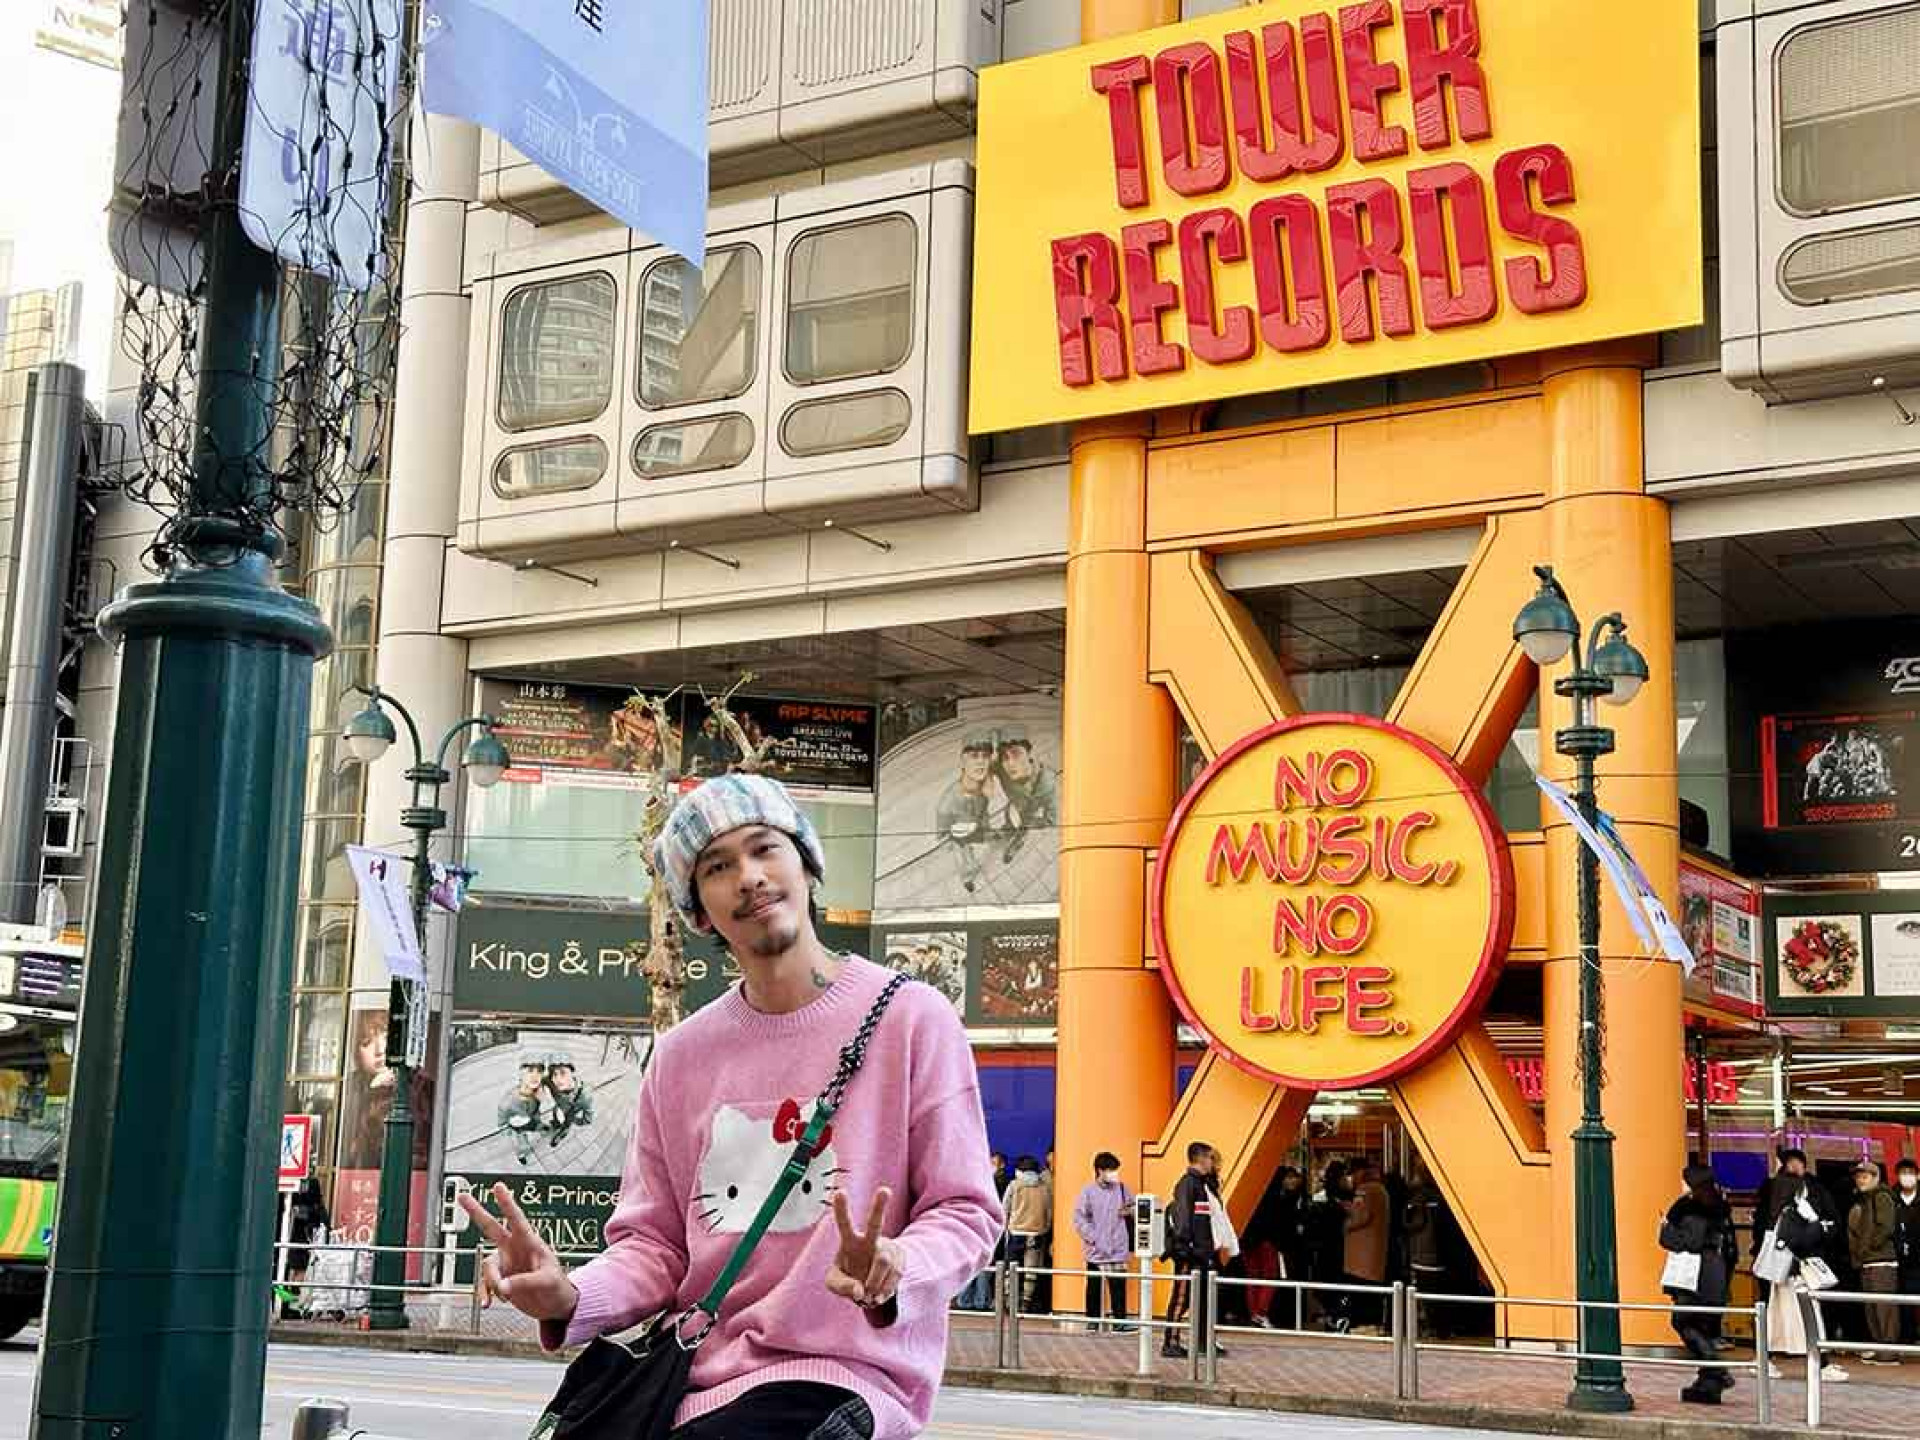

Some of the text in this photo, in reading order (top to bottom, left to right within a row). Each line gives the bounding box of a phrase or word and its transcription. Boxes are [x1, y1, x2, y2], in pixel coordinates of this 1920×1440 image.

[1092, 0, 1491, 209] TOWER
[1050, 143, 1587, 387] RECORDS
[1275, 749, 1372, 811] NO
[1205, 811, 1460, 886] MUSIC,
[1274, 894, 1372, 956] NO
[469, 942, 550, 979] King
[558, 940, 590, 975] &
[1239, 966, 1409, 1035] LIFE.
[520, 1181, 542, 1205] &
[547, 1183, 620, 1206] Prince
